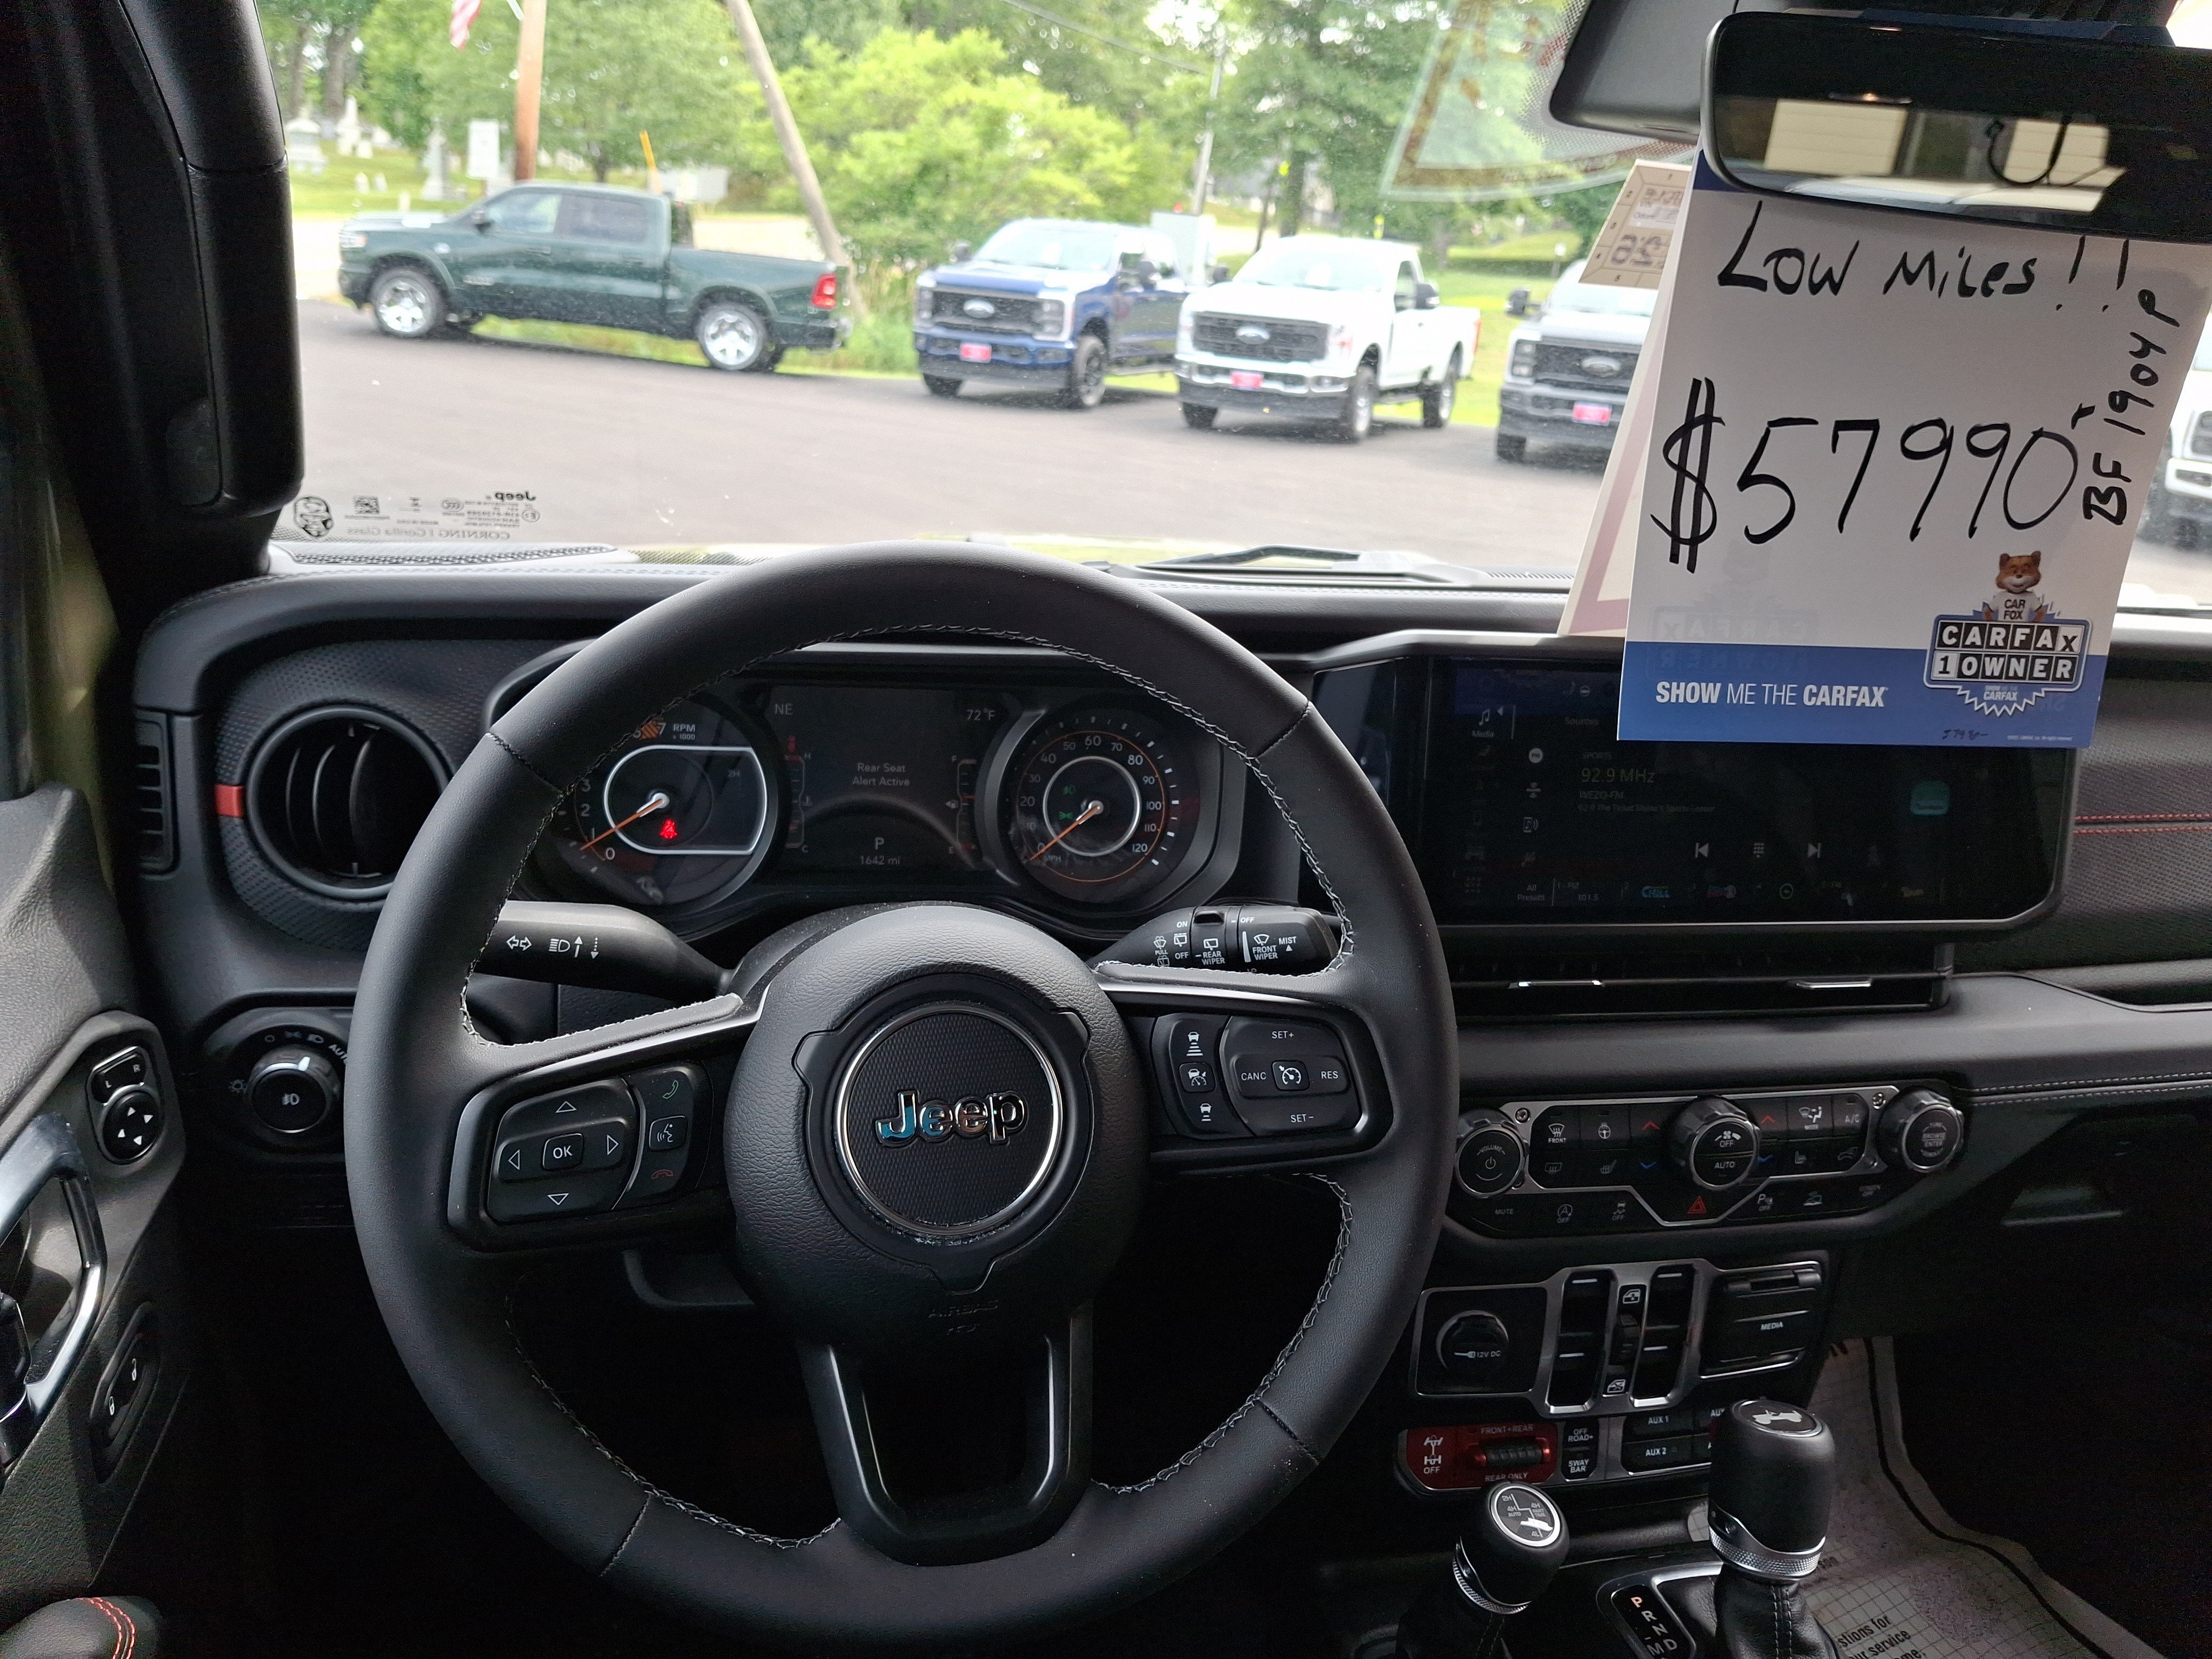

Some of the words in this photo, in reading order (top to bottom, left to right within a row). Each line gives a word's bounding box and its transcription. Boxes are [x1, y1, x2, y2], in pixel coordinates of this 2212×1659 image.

[1718, 200, 1859, 297] Low
[2004, 599, 2025, 608] CAR
[2004, 610, 2023, 620] FOX
[1942, 625, 2078, 653] CARFAX
[1938, 655, 1951, 675] 1
[1962, 657, 2073, 679] OWNER
[1656, 681, 1721, 704] SHOW
[1727, 683, 1756, 704] ME
[1761, 684, 1797, 705] THE
[1803, 684, 1886, 707] CARFAX
[1984, 691, 2018, 701] CARFAX
[775, 704, 794, 715] NE
[658, 723, 666, 735] 7
[673, 723, 696, 732] RPM
[1472, 730, 1495, 738] Media
[1063, 742, 1076, 751] 50
[1085, 736, 1101, 747] 60
[1111, 743, 1123, 752] 70
[1041, 754, 1056, 764] 40
[1128, 755, 1143, 766] 80
[857, 762, 880, 773] Rear
[884, 763, 906, 773] Seat
[1029, 774, 1041, 783] 30
[1581, 767, 1615, 783] 92.9
[1620, 768, 1656, 783] MHz
[582, 779, 591, 791] 3
[852, 776, 877, 787] Alert
[879, 776, 910, 787] Active
[1142, 776, 1155, 785] 90
[1020, 796, 1036, 807] 20
[1146, 801, 1162, 811] 100
[581, 803, 590, 816] 2
[1144, 824, 1156, 832] 110
[874, 837, 884, 850] P
[1132, 843, 1148, 853] 120
[606, 848, 615, 860] 0
[860, 856, 885, 865] 1642
[888, 856, 901, 865] mi
[1278, 936, 1297, 945] MIST
[1252, 946, 1277, 954] FRONT
[1174, 951, 1189, 960] OFF
[1253, 952, 1278, 961] WIPER
[1201, 957, 1226, 966] WIPER
[1271, 1030, 1294, 1039] SET+
[133, 1064, 141, 1073] R
[1241, 1071, 1266, 1081] CANC
[1321, 1070, 1339, 1079] RES
[105, 1080, 112, 1089] L
[877, 1090, 1026, 1144] Jeep
[1844, 1115, 1860, 1124] A/C
[1719, 1140, 1734, 1148] OFF
[552, 1145, 573, 1159] OK
[1480, 1145, 1503, 1154] VOLUME
[1714, 1161, 1735, 1169] AUTO
[1760, 1321, 1784, 1330] MEDIA
[1648, 1416, 1663, 1425] AUX
[1645, 1449, 1661, 1457] AUX
[1662, 1447, 1667, 1455] 2
[1568, 1459, 1590, 1467] SWAY
[1423, 1467, 1441, 1475] OFF
[1570, 1465, 1586, 1474] BAR
[1485, 1474, 1507, 1482] REAR
[1630, 1596, 1642, 1608] P
[1641, 1610, 1658, 1622] R
[1651, 1623, 1669, 1636] N
[1837, 1624, 1874, 1648] stions
[1870, 1615, 1891, 1630] for
[1663, 1638, 1677, 1651] D
[1868, 1630, 1911, 1656] service
[1646, 1642, 1664, 1656] M
